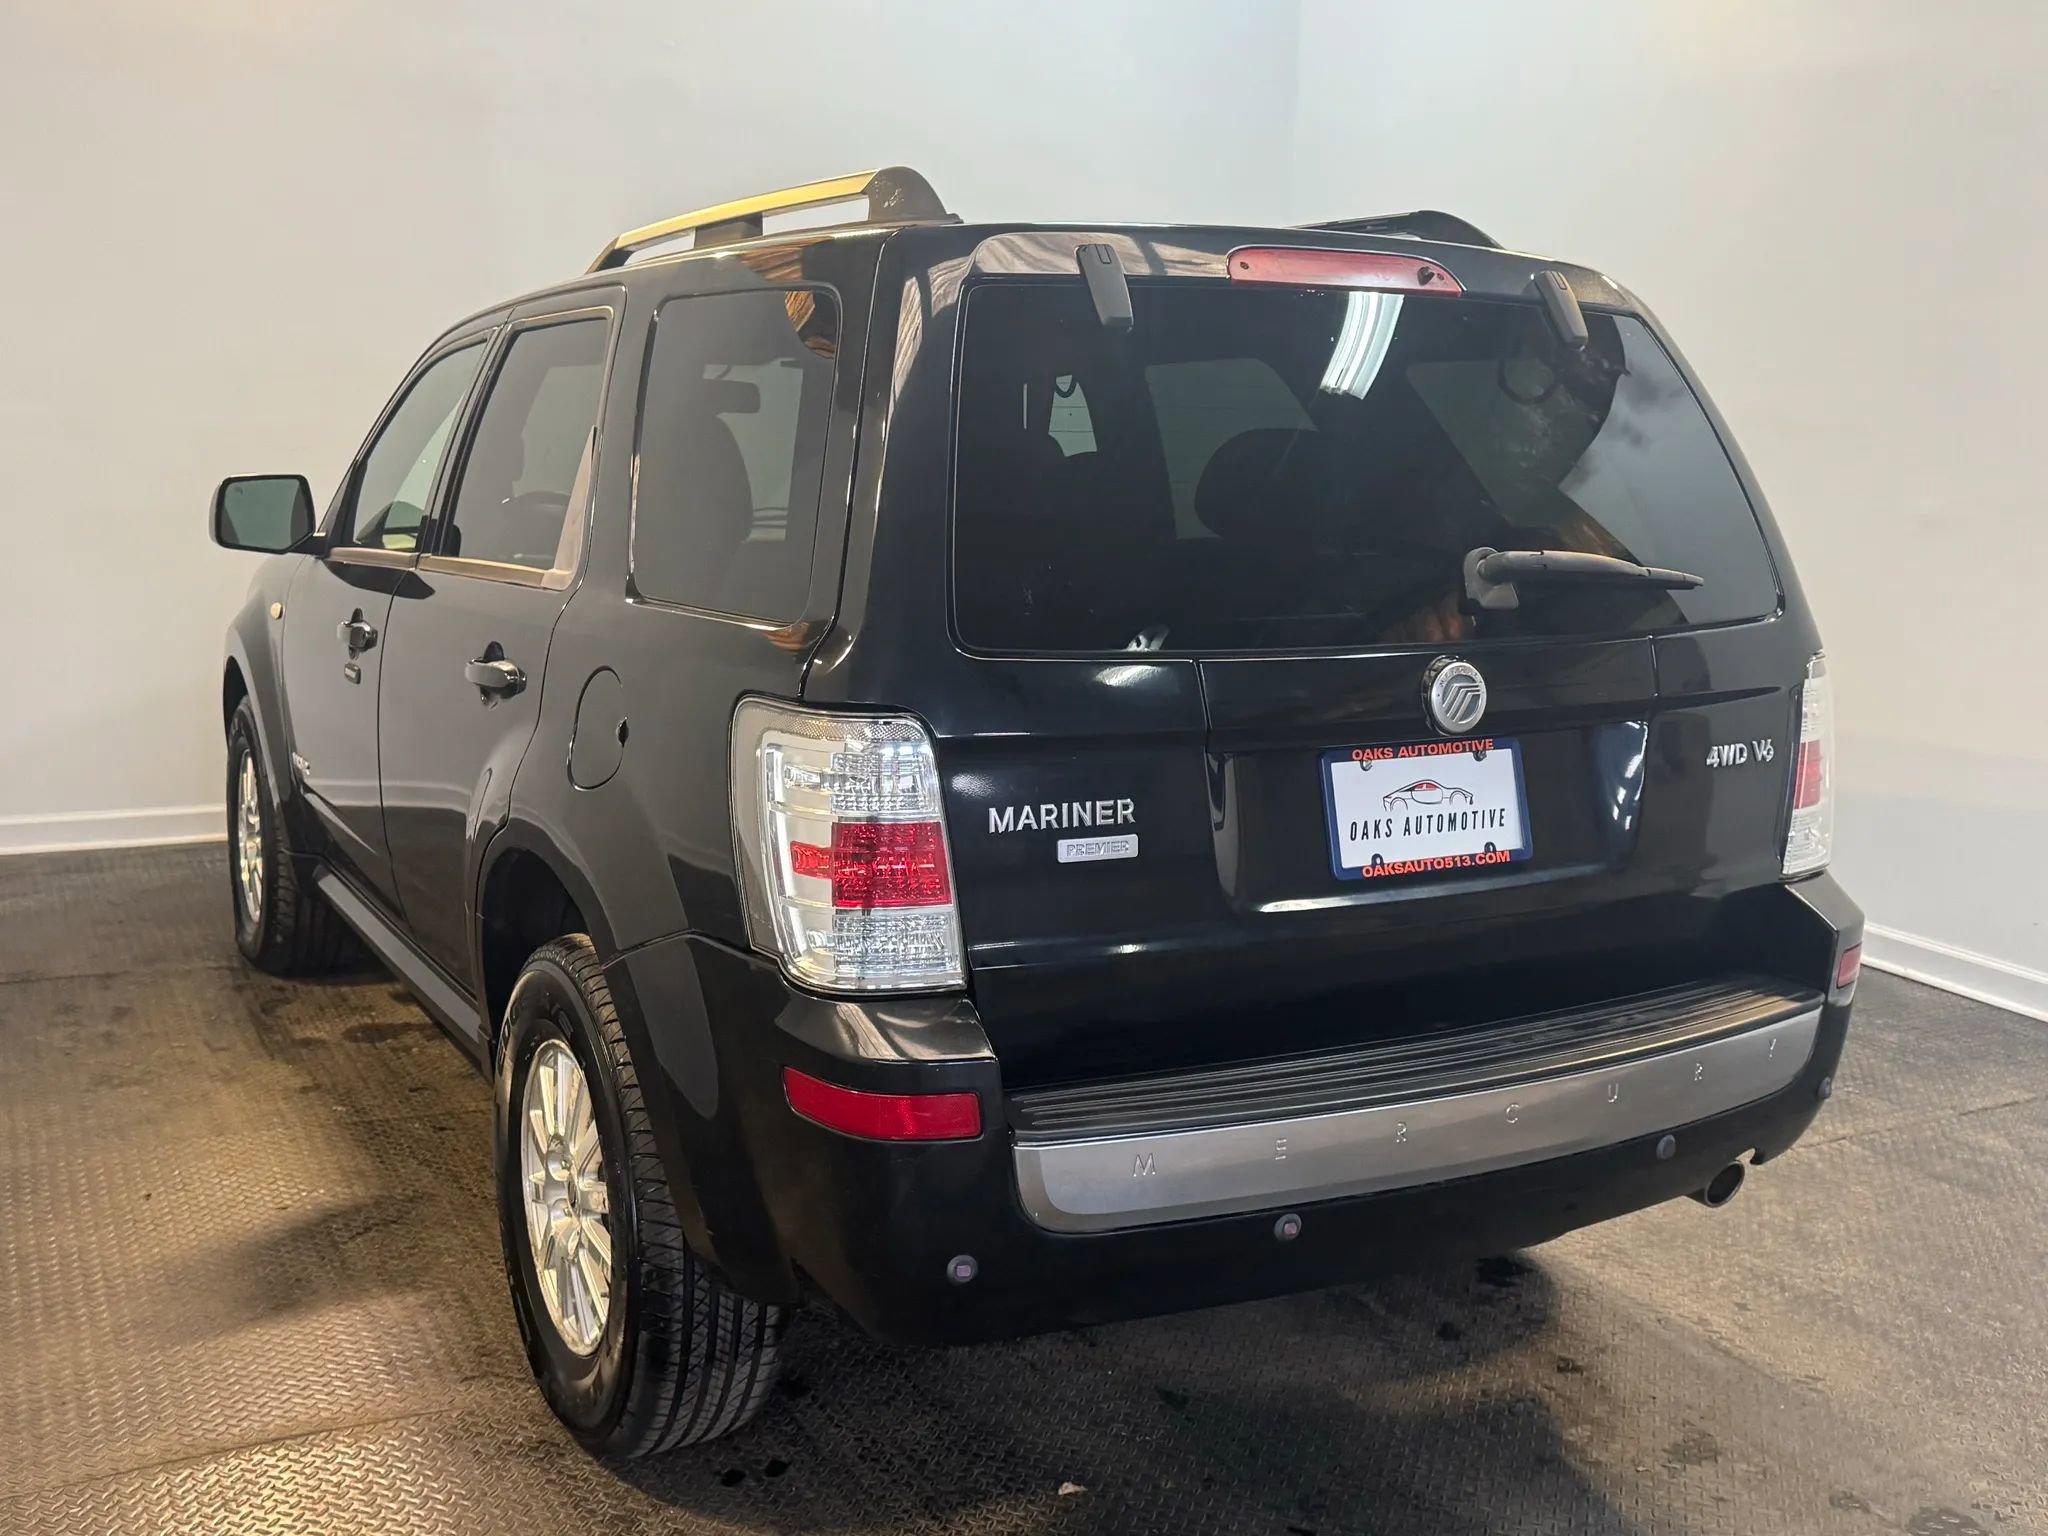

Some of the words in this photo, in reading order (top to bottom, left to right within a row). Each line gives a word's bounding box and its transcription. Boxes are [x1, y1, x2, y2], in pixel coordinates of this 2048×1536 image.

[1351, 746, 1394, 761] OAKS
[1397, 739, 1494, 759] AUTOMOTIVE
[1706, 743, 1748, 768] 4WD
[1751, 739, 1774, 762] V6
[988, 798, 1136, 834] MARINER
[1350, 817, 1393, 841] OAKS
[1403, 808, 1506, 837] AUTOMOTIVE
[1066, 840, 1130, 857] PREMIER
[1362, 850, 1511, 879] OAKSAUTO513.COM
